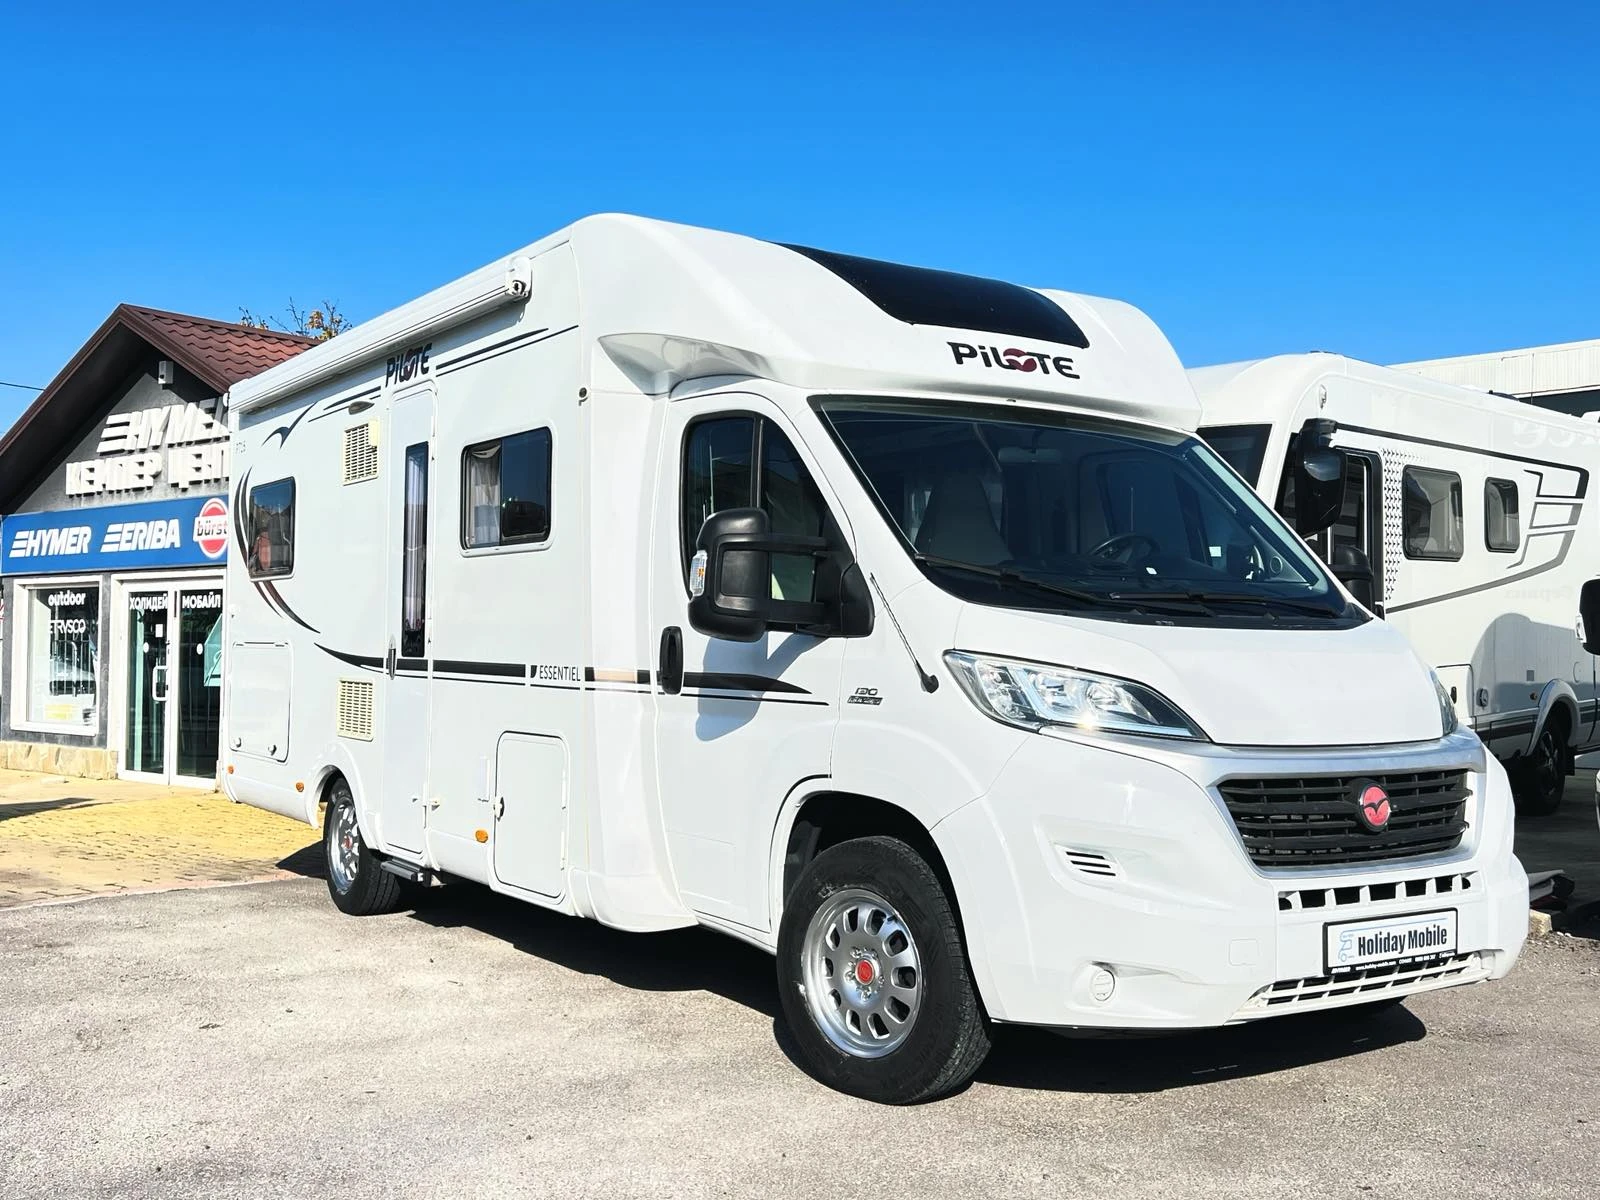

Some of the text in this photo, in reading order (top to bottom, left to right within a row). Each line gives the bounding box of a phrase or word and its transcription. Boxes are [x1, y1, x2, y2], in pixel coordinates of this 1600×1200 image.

[168, 441, 230, 488] ЦЕН
[9, 526, 92, 558] HYMER
[100, 519, 181, 553] ERIBA
[48, 590, 86, 606] outdoor
[129, 592, 221, 611] ХОЛИДЕЙ МОБАЙЛ
[539, 665, 581, 682] ESSENTIEL
[1358, 924, 1448, 957] Holiday Mobile
